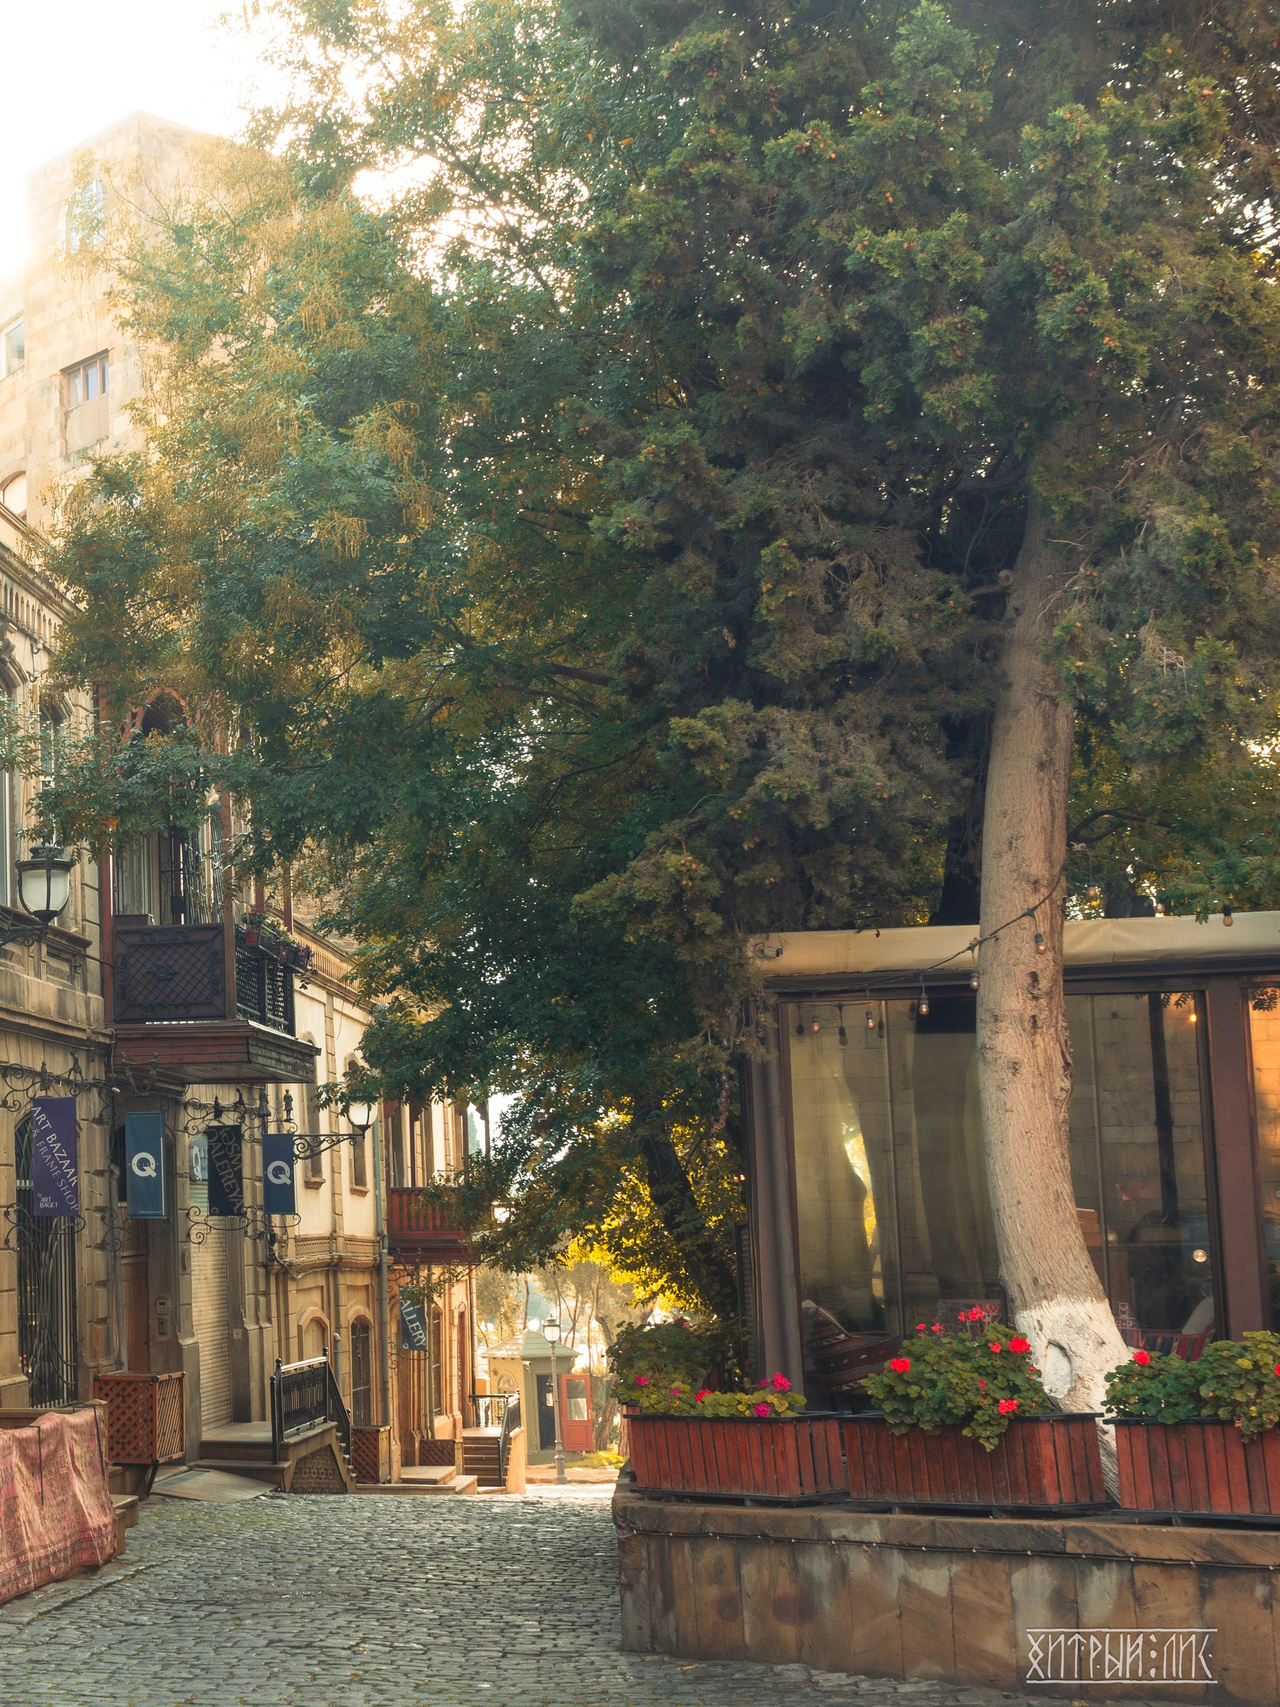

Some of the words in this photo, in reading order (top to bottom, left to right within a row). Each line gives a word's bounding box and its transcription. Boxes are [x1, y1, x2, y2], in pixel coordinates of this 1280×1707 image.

[31, 1106, 52, 1131] ART
[32, 1128, 40, 1138] &
[36, 1141, 61, 1178] FRAME
[131, 1152, 158, 1178] Q
[267, 1160, 292, 1186] Q
[400, 1296, 426, 1347] ALLERY
